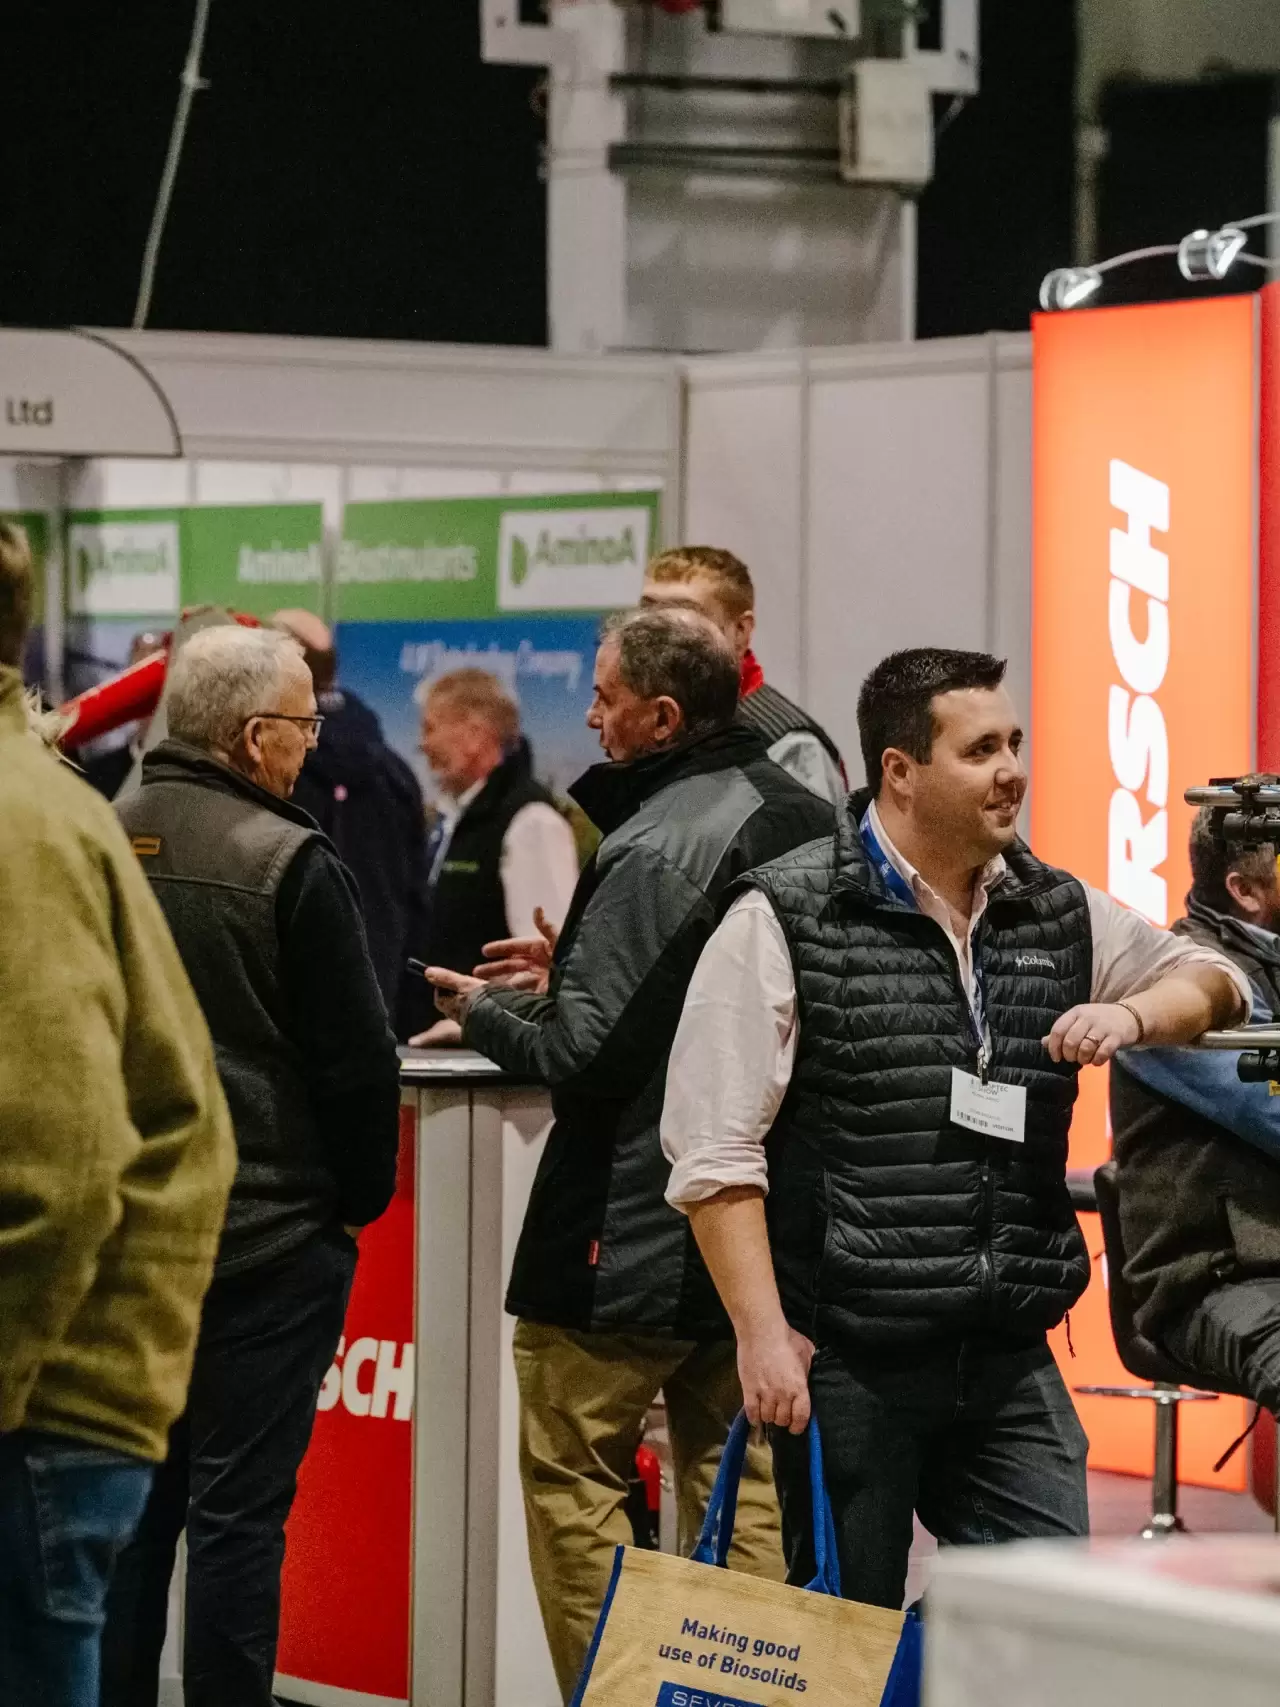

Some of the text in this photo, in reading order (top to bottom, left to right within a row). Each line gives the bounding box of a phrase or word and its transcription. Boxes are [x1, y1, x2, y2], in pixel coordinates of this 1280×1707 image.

[5, 396, 54, 426] Ltd
[534, 523, 637, 569] AminoA
[1107, 459, 1169, 927] RSCH
[680, 1617, 802, 1662] Making good
[658, 1643, 808, 1693] use of Biosolids
